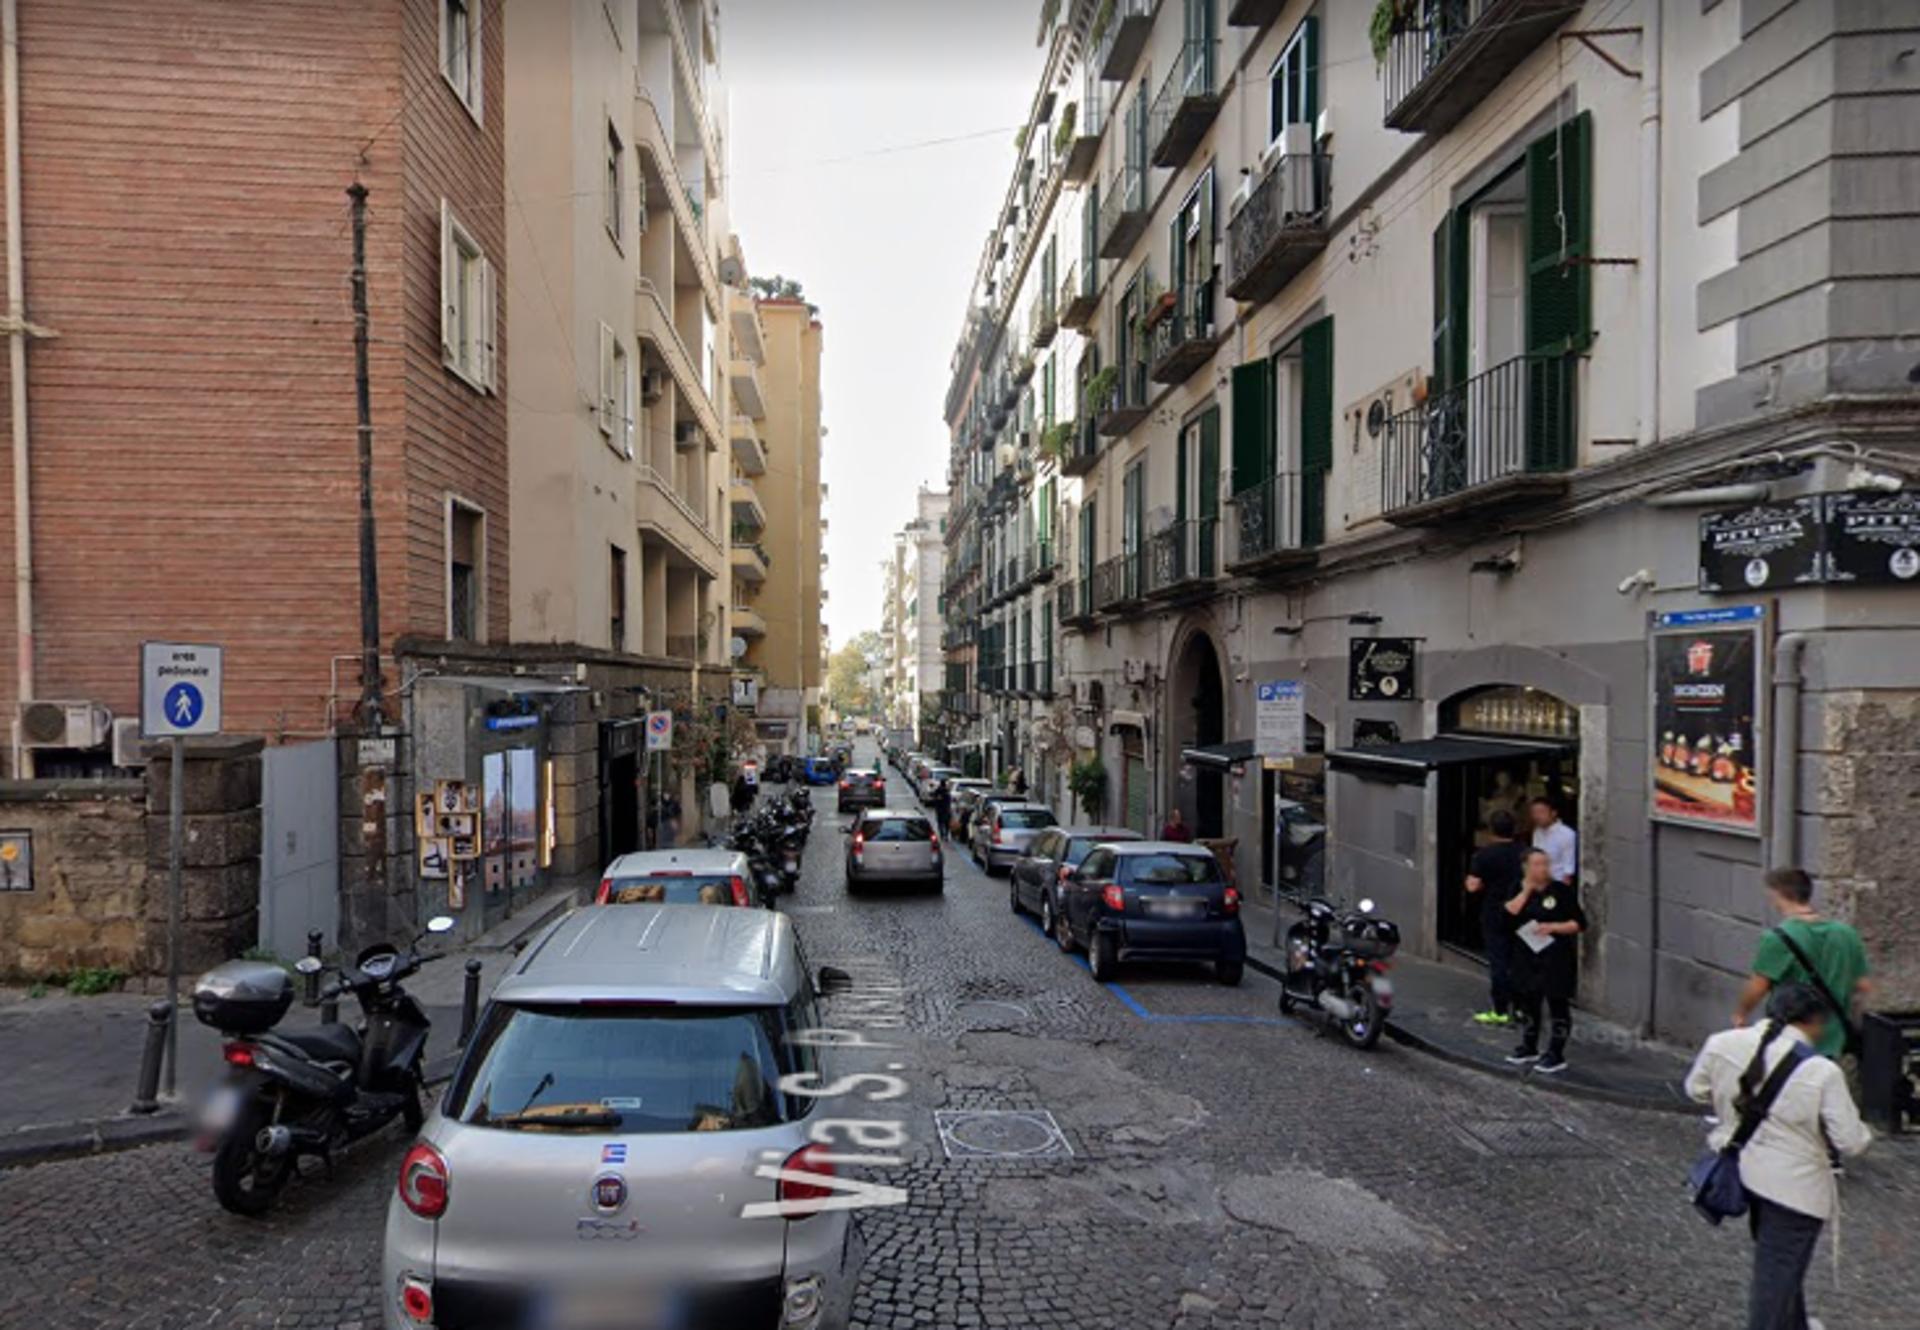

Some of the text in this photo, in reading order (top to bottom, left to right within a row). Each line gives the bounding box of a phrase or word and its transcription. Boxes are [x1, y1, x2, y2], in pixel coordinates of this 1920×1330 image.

[171, 652, 197, 662] area
[157, 664, 210, 677] pedonale
[1260, 686, 1272, 698] P
